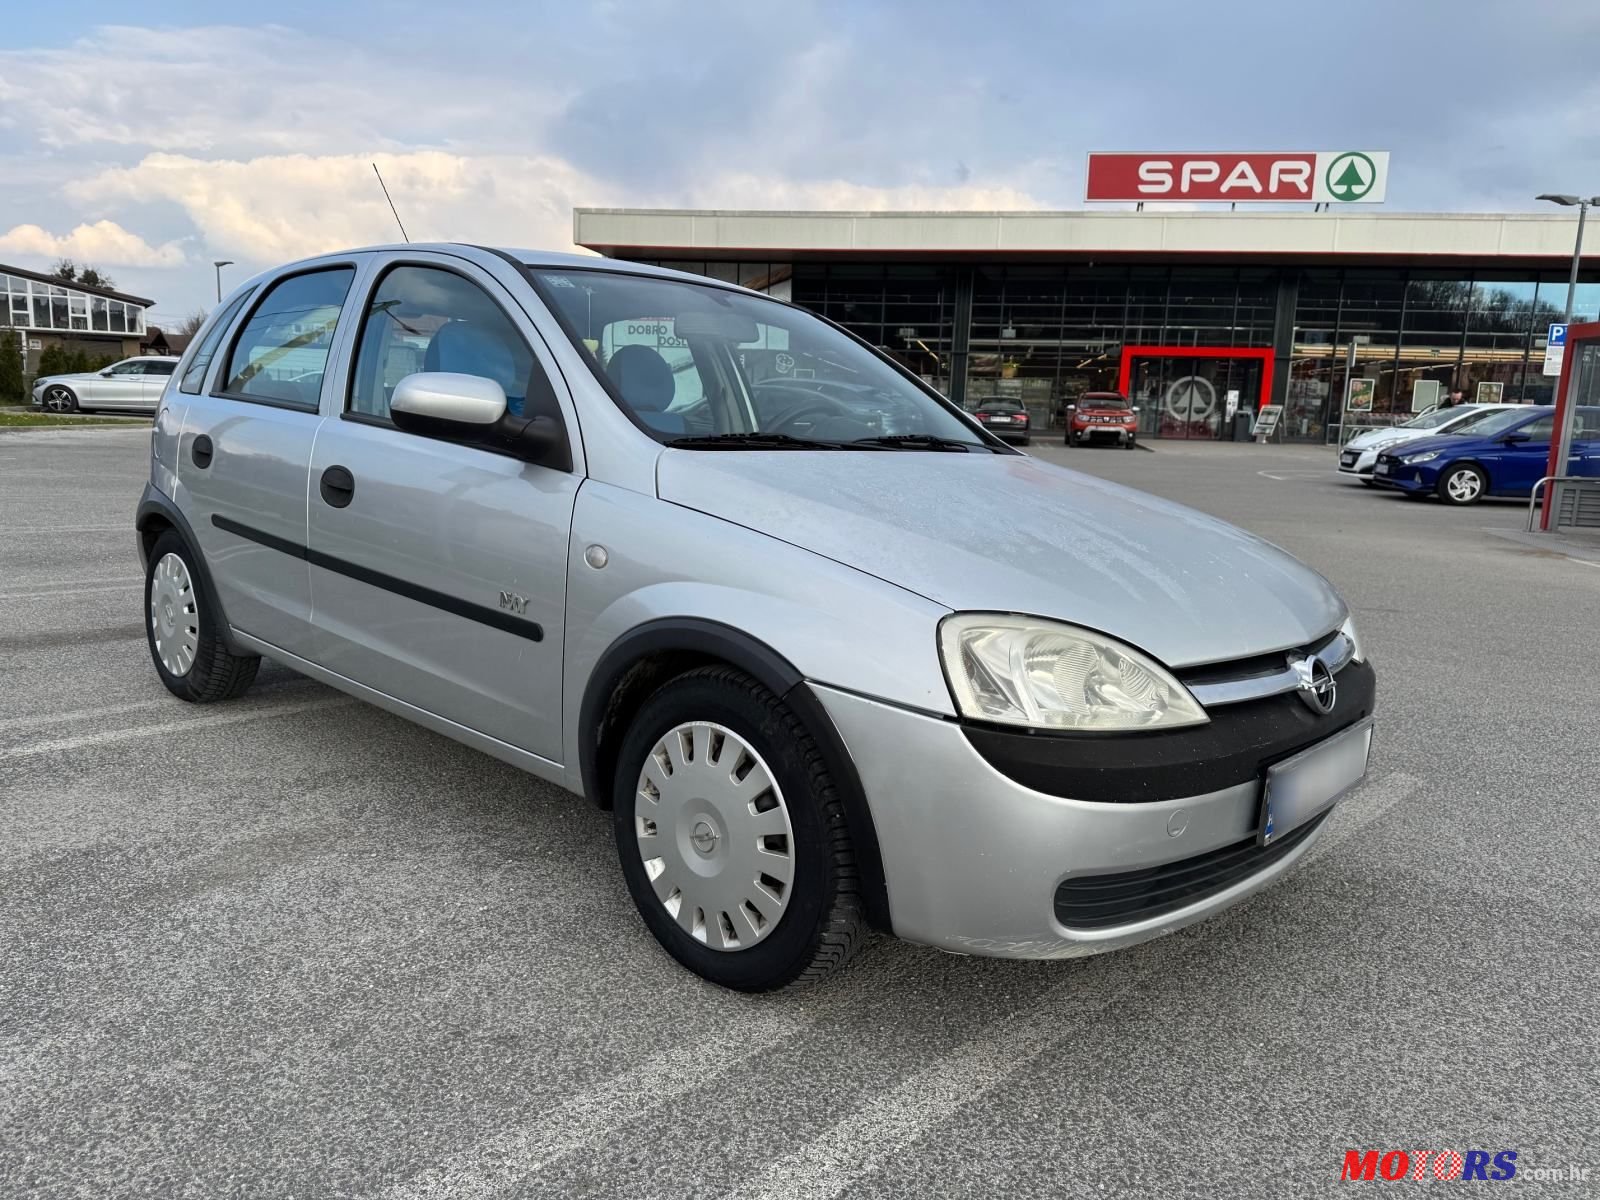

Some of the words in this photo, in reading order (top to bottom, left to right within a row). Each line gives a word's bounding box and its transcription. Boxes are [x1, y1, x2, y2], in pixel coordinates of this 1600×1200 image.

[1138, 160, 1311, 193] SPAR
[628, 324, 668, 335] DOBRO
[1552, 326, 1564, 340] P
